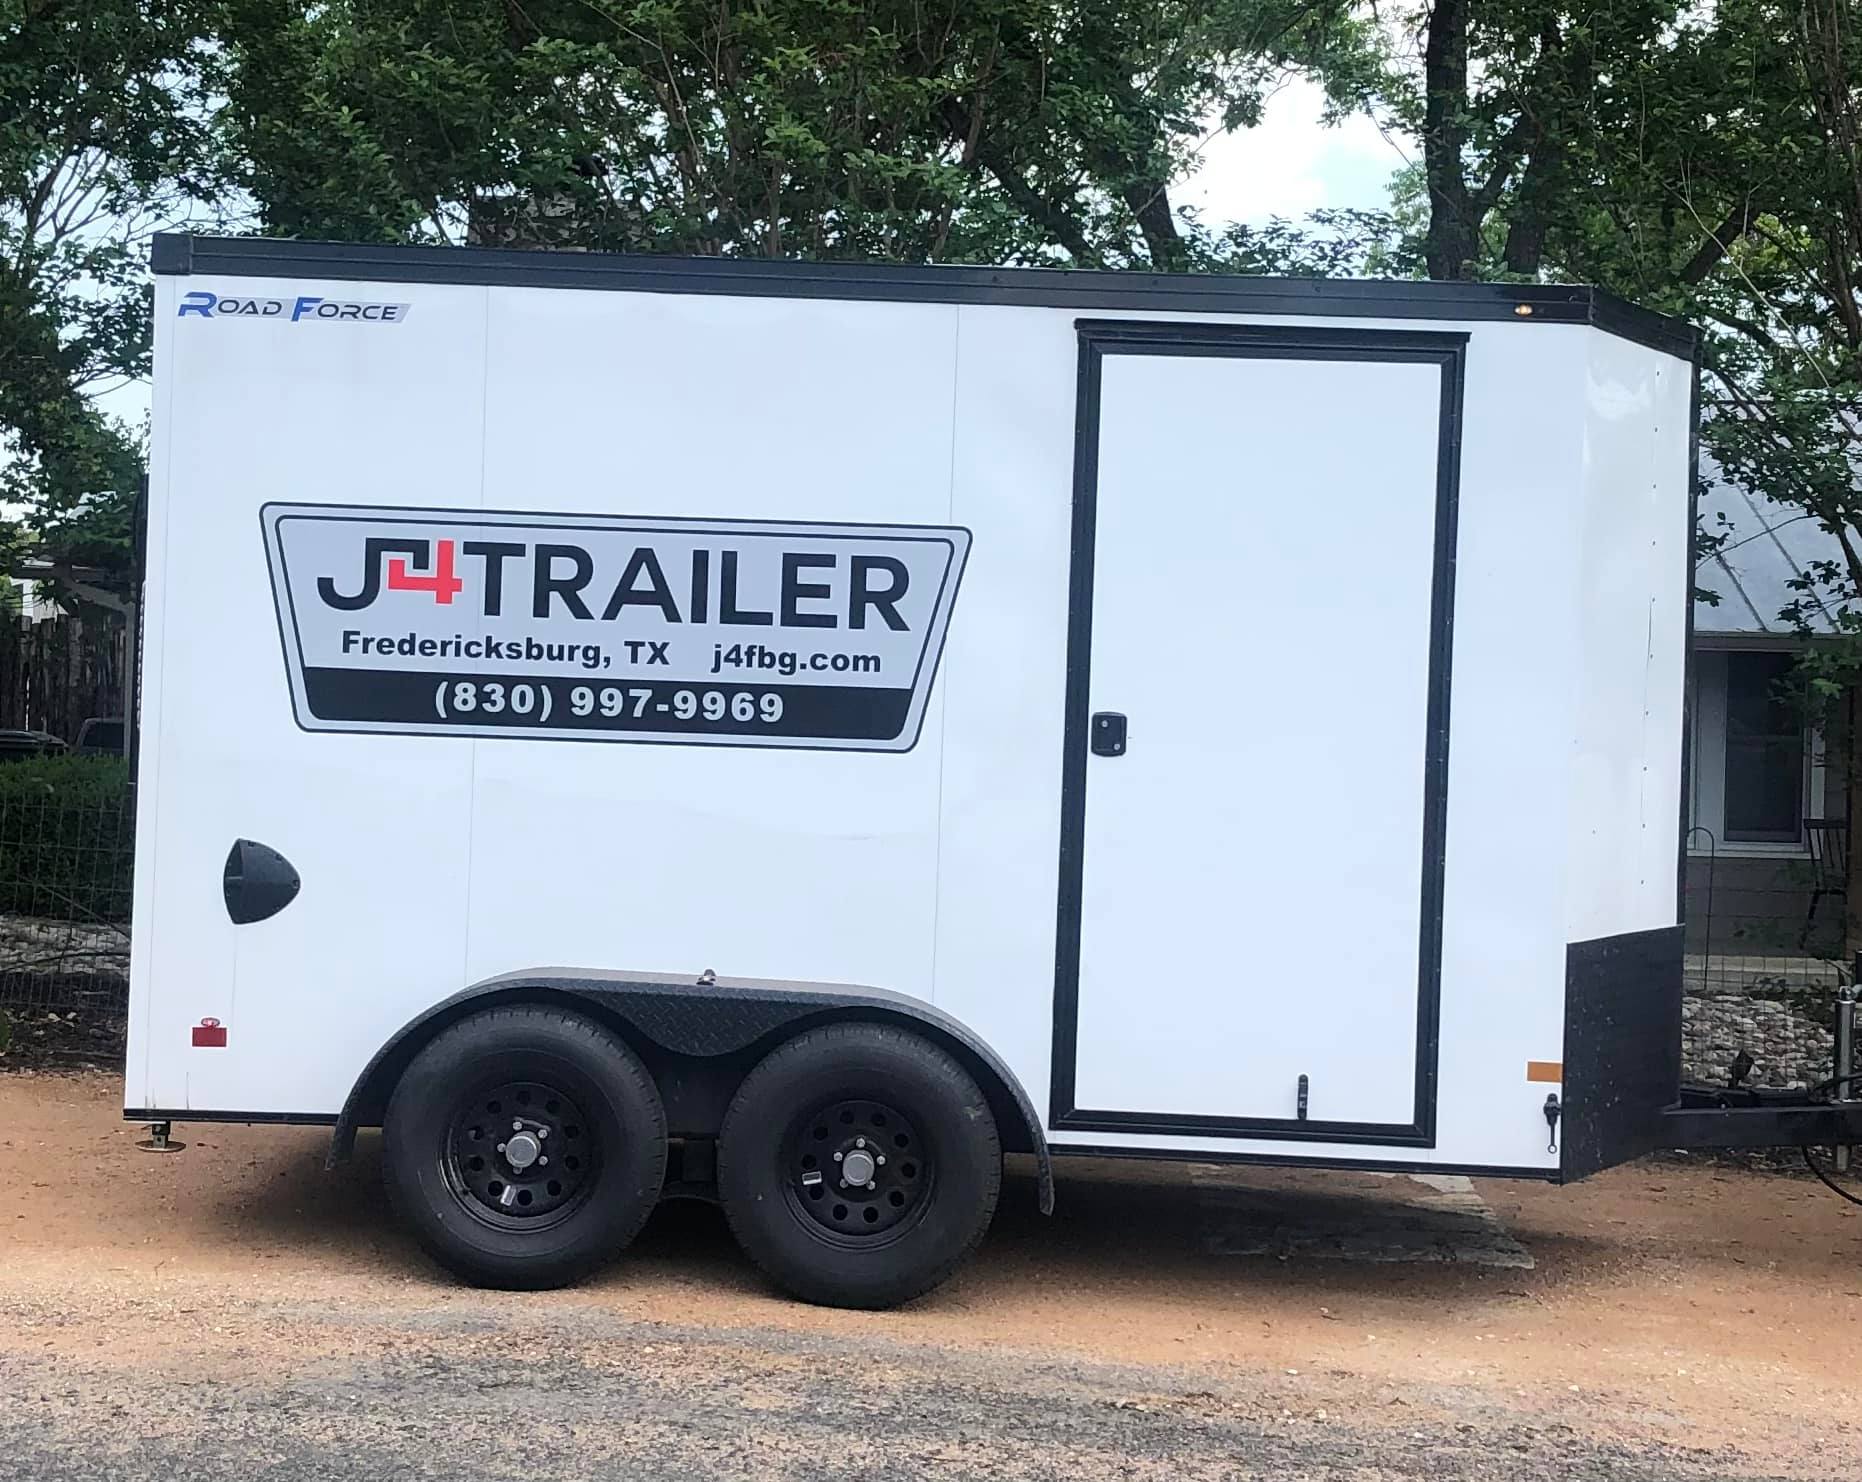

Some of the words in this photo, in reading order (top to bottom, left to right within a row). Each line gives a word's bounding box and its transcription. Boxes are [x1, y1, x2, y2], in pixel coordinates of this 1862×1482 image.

[178, 292, 283, 318] ROAD
[291, 297, 399, 322] FORCE
[342, 630, 612, 669] Fredericksburg,
[624, 641, 670, 665] TX
[711, 644, 881, 676] j4fbg.com
[435, 681, 553, 722] (830)
[570, 687, 784, 723] 997-9969
